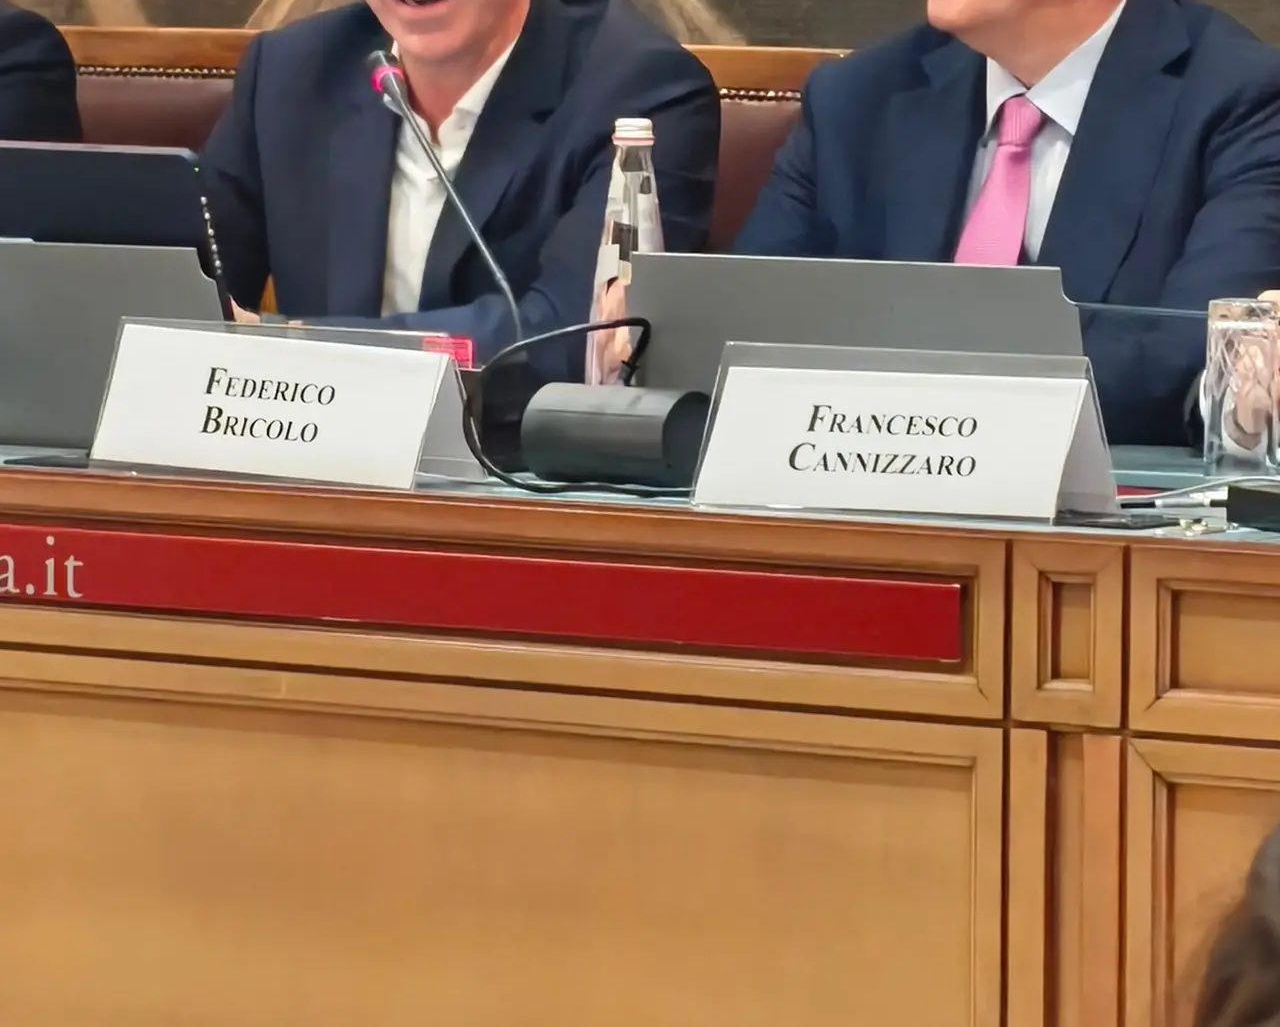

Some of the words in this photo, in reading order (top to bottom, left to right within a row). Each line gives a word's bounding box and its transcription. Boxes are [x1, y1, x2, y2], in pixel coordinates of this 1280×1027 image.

[203, 366, 337, 406] FEDERICO
[199, 404, 319, 444] BRICOLO
[805, 403, 979, 438] FRANCESCO
[787, 441, 977, 478] CANNIZZARO
